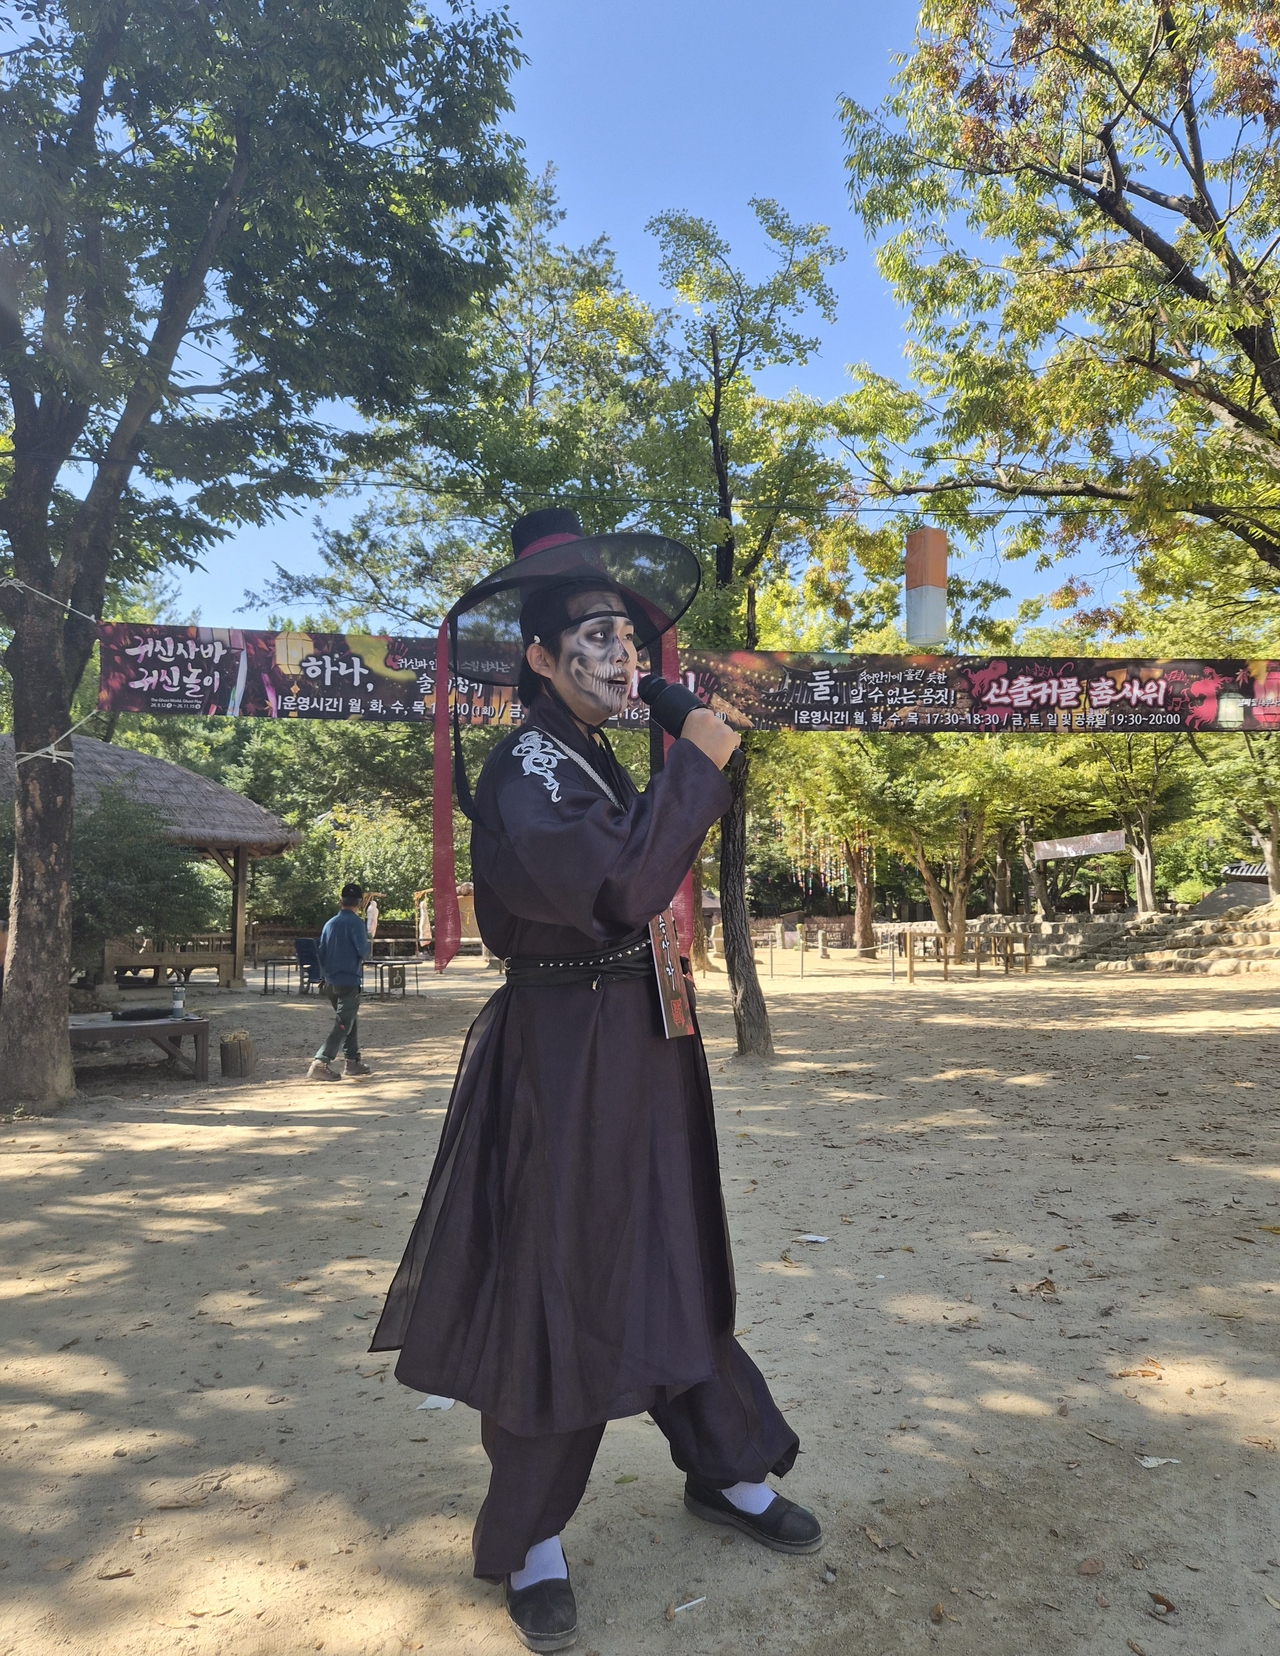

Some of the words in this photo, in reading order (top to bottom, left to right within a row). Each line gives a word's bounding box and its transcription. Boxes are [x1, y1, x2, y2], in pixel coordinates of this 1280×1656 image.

[125, 635, 227, 664] 귀신사바
[302, 655, 374, 692] 하나,
[398, 657, 428, 670] 귀신과
[128, 662, 220, 697] 귀신놀이
[416, 673, 483, 697] 술잡기
[807, 670, 839, 704] 둘,
[926, 672, 947, 684] 듯한
[850, 686, 866, 704] 알
[868, 686, 884, 704] 수
[887, 687, 916, 704] 없는
[918, 687, 955, 705] 몸짓!
[981, 675, 1082, 708] 신출귀몰
[1089, 676, 1167, 707] 춤사위
[348, 698, 365, 714] 월,
[369, 699, 386, 715] 화,
[390, 700, 408, 715] 수,
[412, 701, 426, 715] 목
[509, 704, 525, 719] 금,
[853, 711, 868, 726] 월,
[871, 711, 886, 726] 화,
[889, 712, 904, 726] 수,
[907, 712, 919, 725] 목
[1011, 713, 1026, 727] 금,
[1029, 713, 1044, 727] 토,
[1047, 713, 1057, 725] 일
[1062, 713, 1071, 726] 및
[1075, 713, 1107, 726] 공휴일
[1111, 713, 1181, 725] 19:30~20:00
